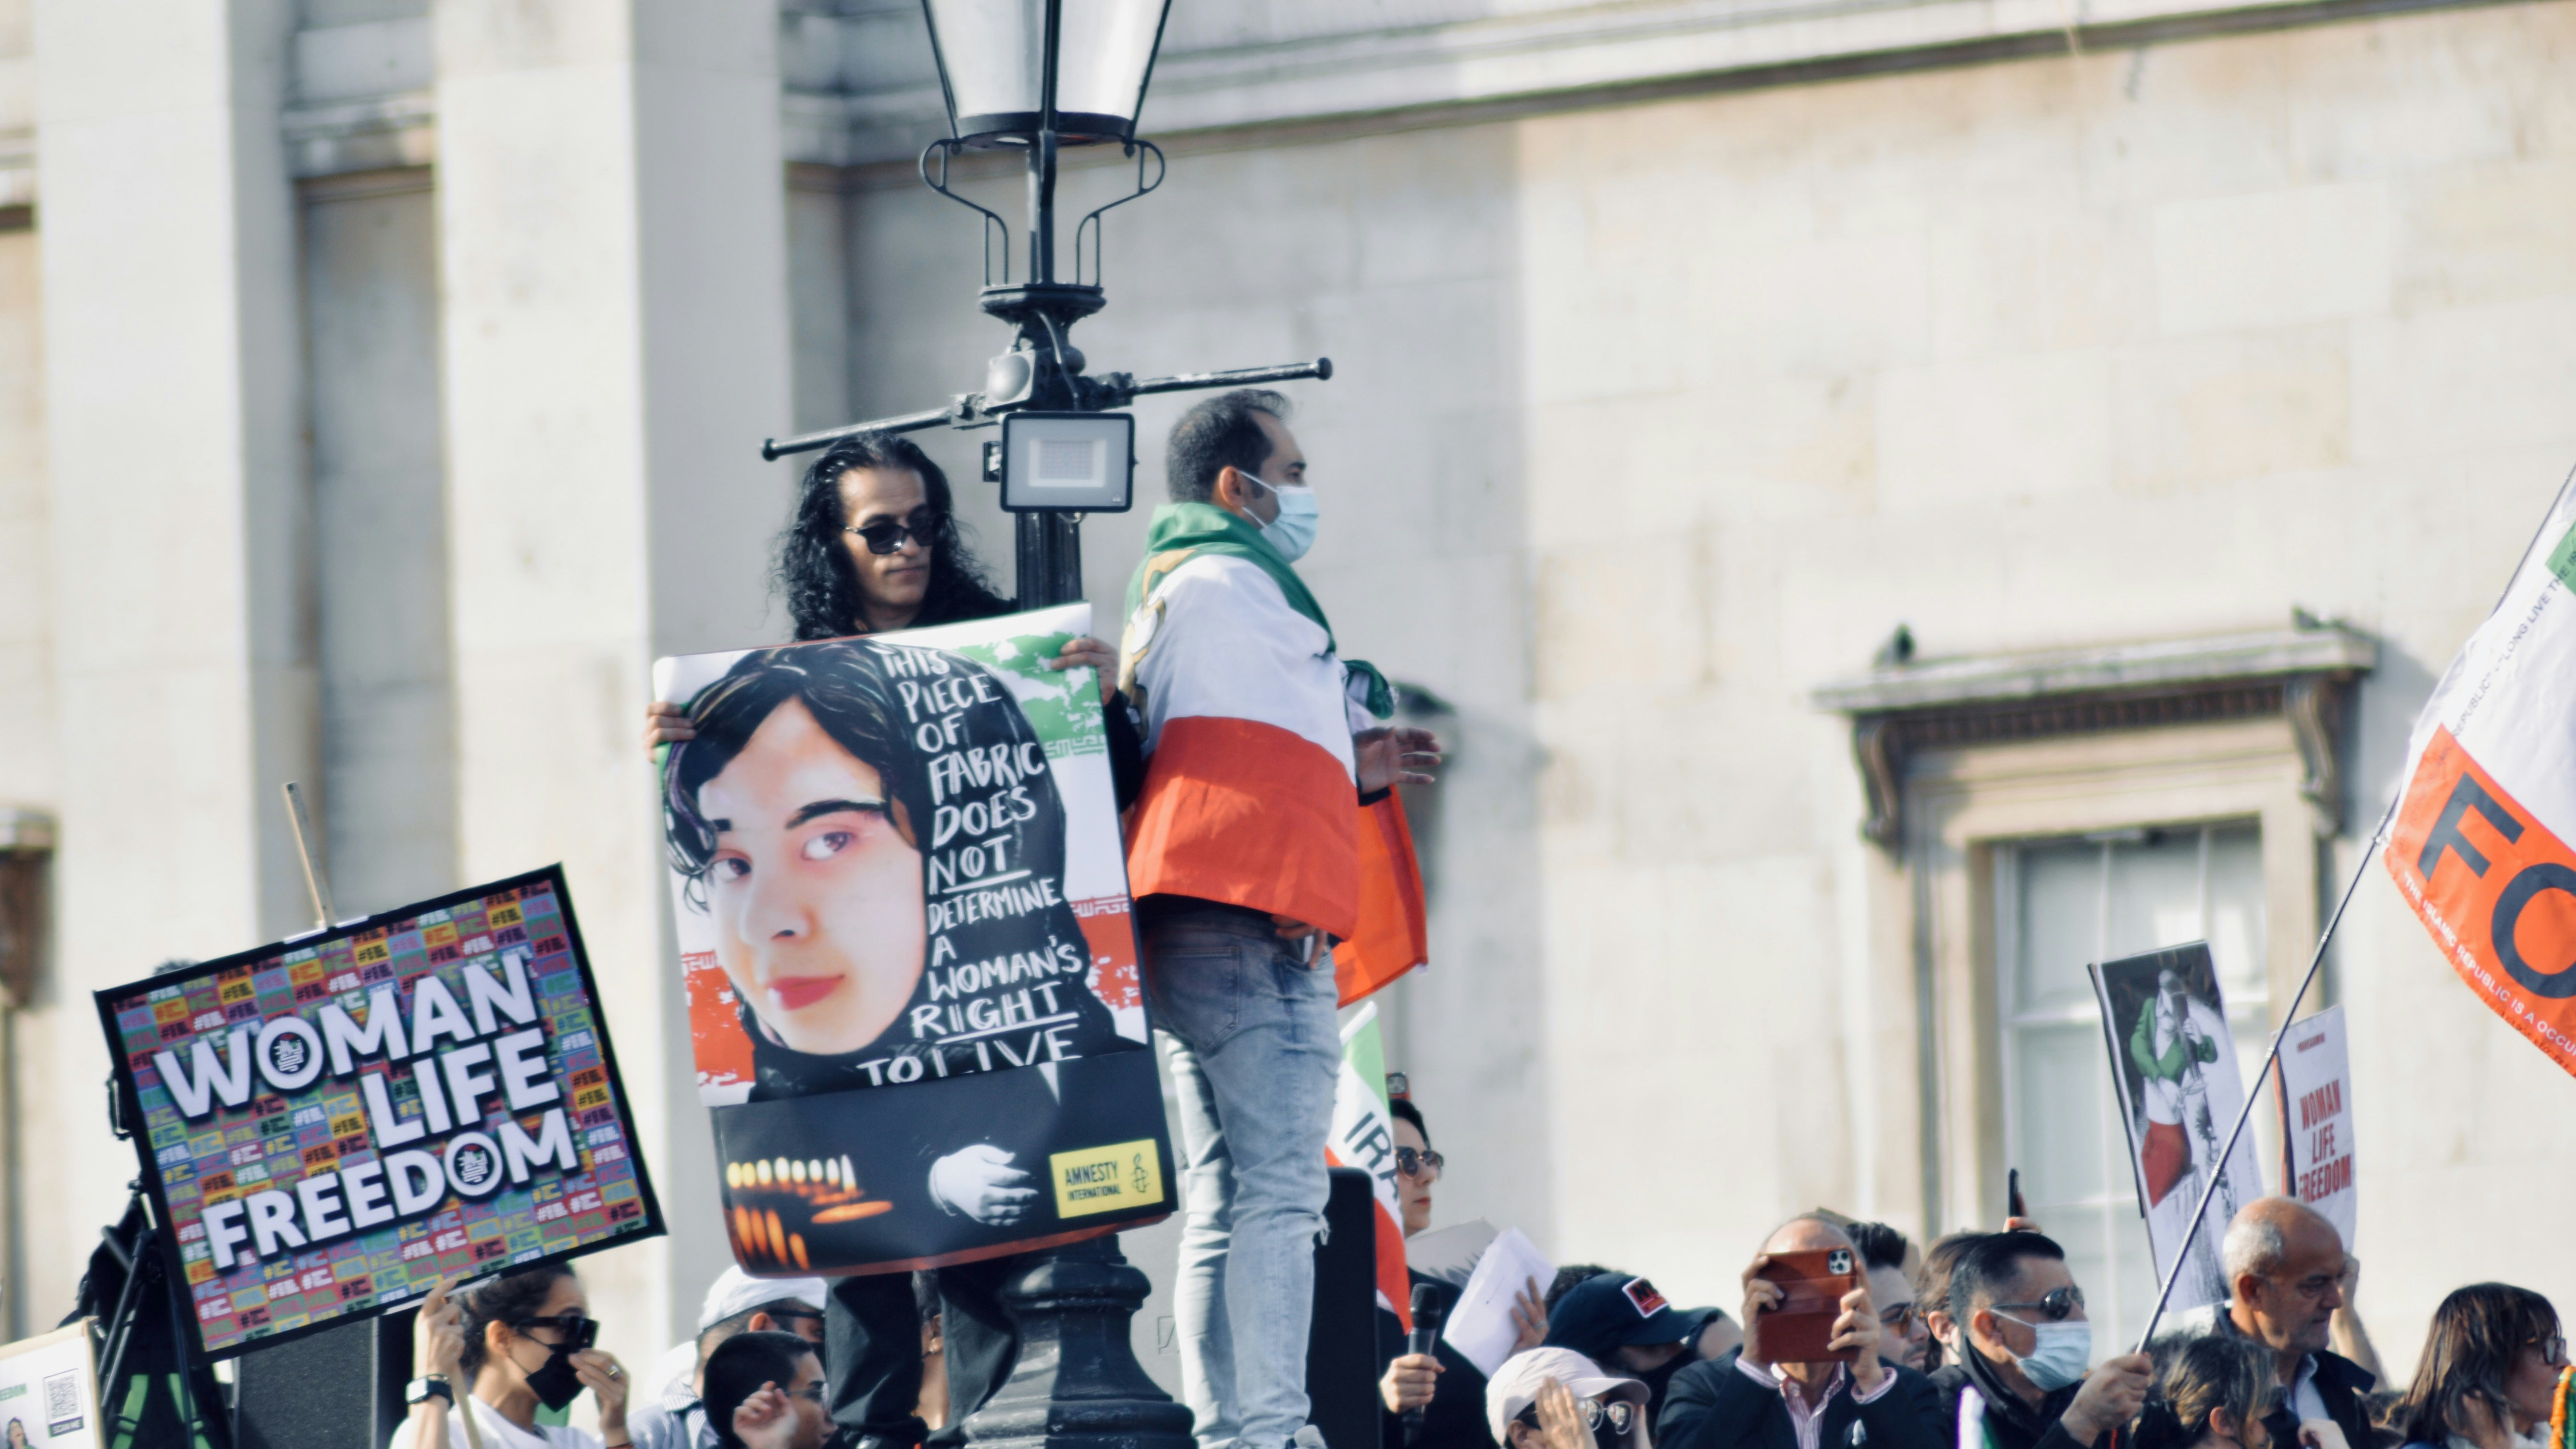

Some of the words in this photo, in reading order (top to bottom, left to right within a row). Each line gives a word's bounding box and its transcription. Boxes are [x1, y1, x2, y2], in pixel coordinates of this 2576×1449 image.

[2526, 592, 2552, 623] LIVE
[2547, 565, 2571, 592] THE
[865, 644, 951, 678] THIS
[897, 673, 1002, 724] PIECE
[916, 713, 964, 753] OF
[928, 742, 1045, 805] FABRIC
[932, 786, 1037, 850] DOES
[929, 834, 1013, 895] NOT
[927, 878, 1062, 936] DETERMINE
[927, 935, 1083, 1002] WOMAN'S
[932, 935, 957, 967] A
[2423, 899, 2457, 947] ISLAMIC
[2456, 944, 2511, 1002] REPUBLIC
[2510, 998, 2525, 1015] IS
[2524, 1011, 2535, 1025] A
[2536, 1020, 2576, 1056] OCCU
[151, 953, 537, 1119] WOMAN
[909, 981, 1063, 1039] RIGHT
[360, 1027, 561, 1148] LIFE
[855, 1055, 924, 1087] TO
[2300, 1079, 2342, 1131] WOMAN
[2311, 1123, 2336, 1165] LIFE
[201, 1107, 579, 1270] FREEDOM
[1065, 1161, 1118, 1187] AMNESTY
[1067, 1184, 1122, 1201] INTERNATIONAL
